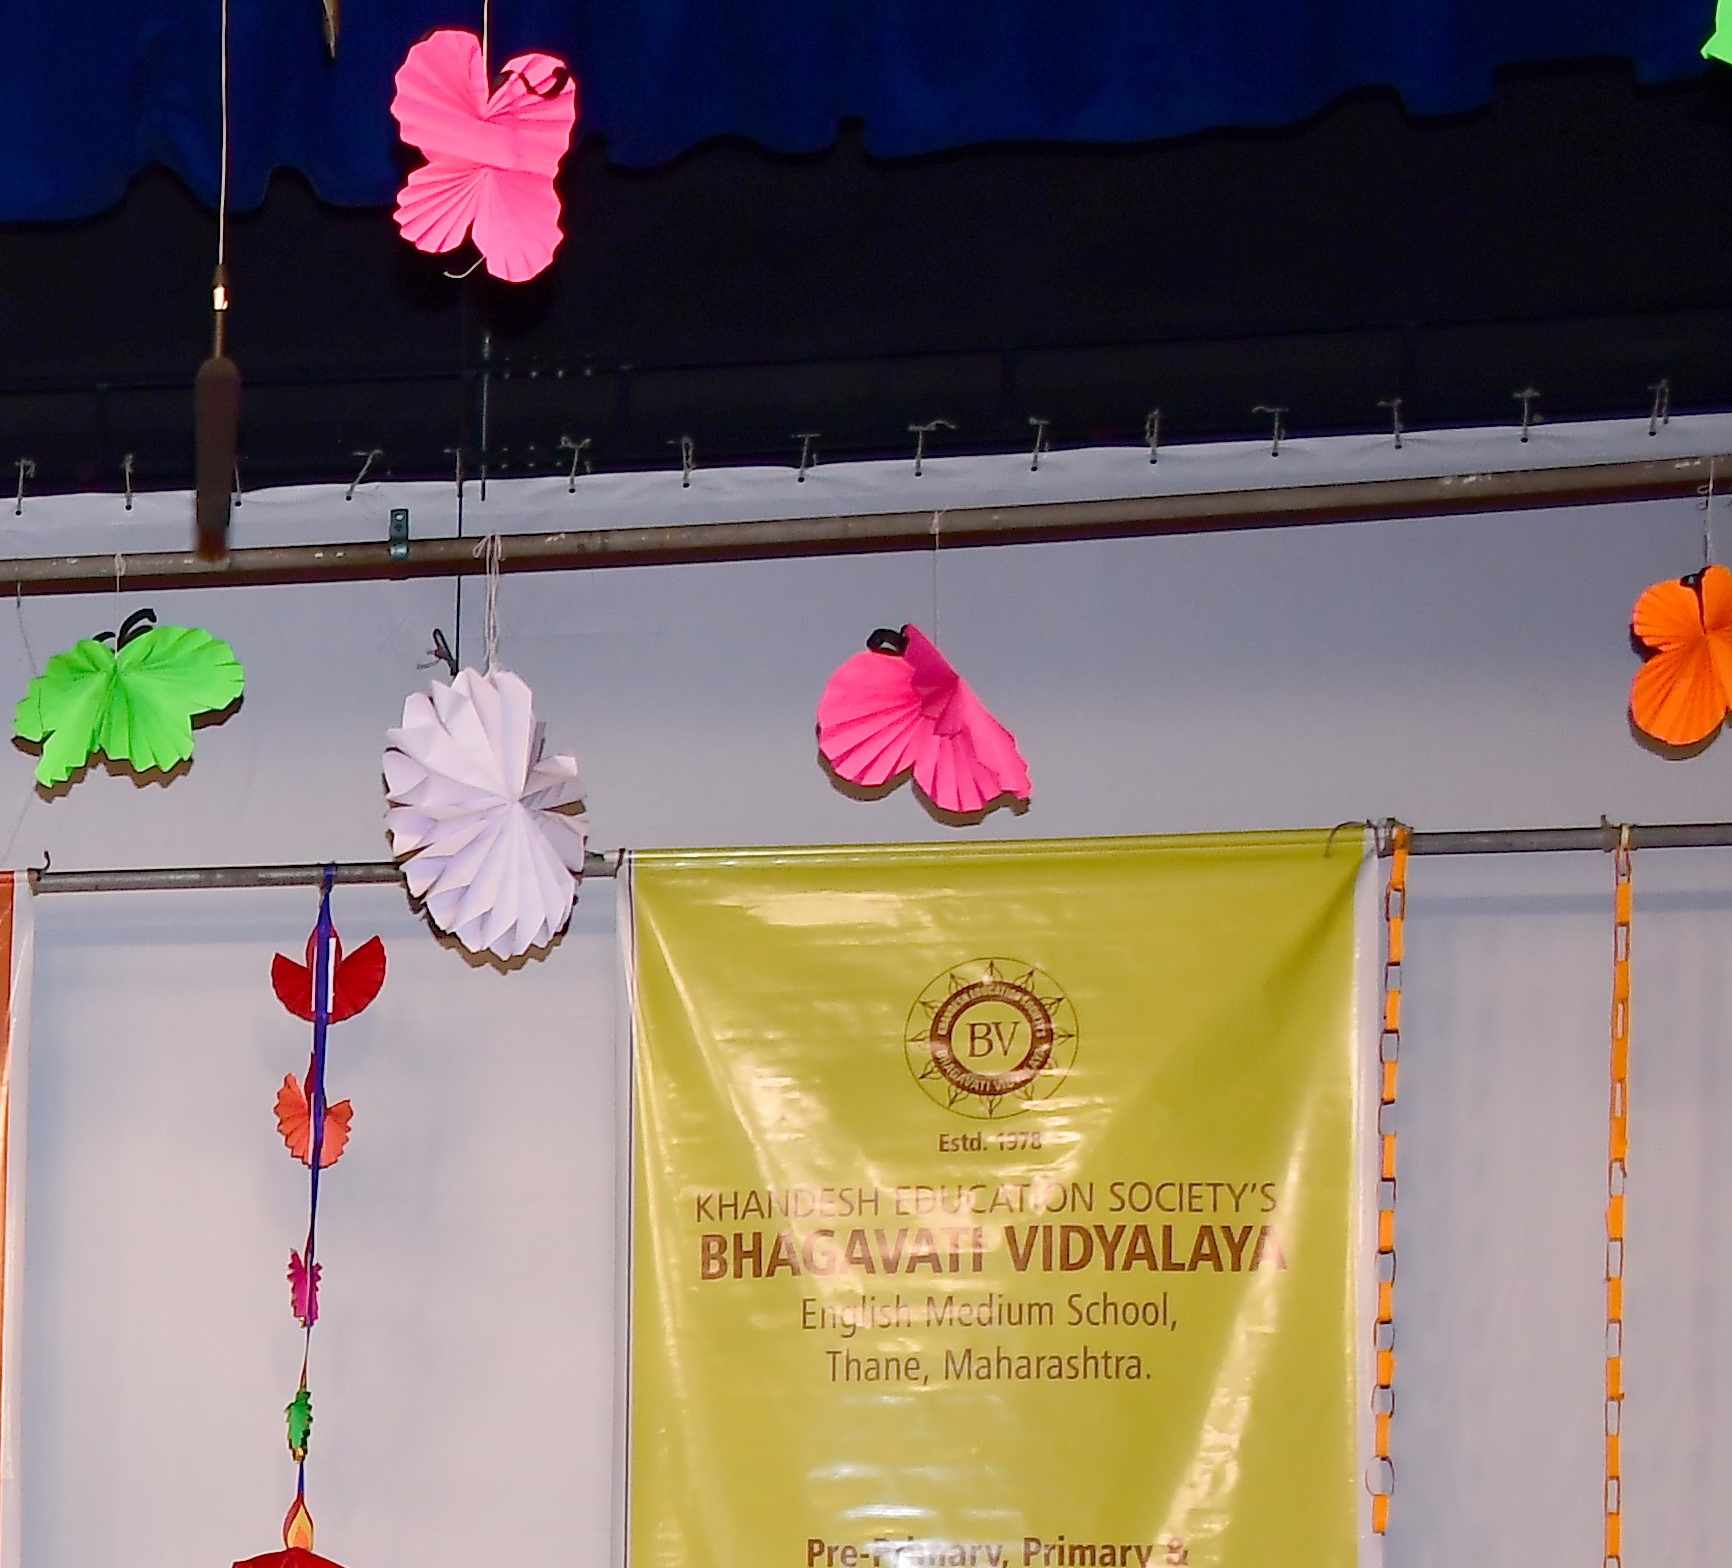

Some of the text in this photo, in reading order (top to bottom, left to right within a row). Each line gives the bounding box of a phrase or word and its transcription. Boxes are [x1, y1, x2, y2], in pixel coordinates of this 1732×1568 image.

[965, 1020, 1021, 1058] BV
[938, 1131, 987, 1152] Estd.
[696, 1181, 1278, 1222] KHANDESH EDUCATON SOCIETY'S
[701, 1224, 1287, 1280] BHAGAVATI VIDYALAYA
[801, 1291, 1177, 1338] English Medium School,
[826, 1345, 1151, 1385] Thane, Maharashtra.
[1166, 1536, 1189, 1568] &
